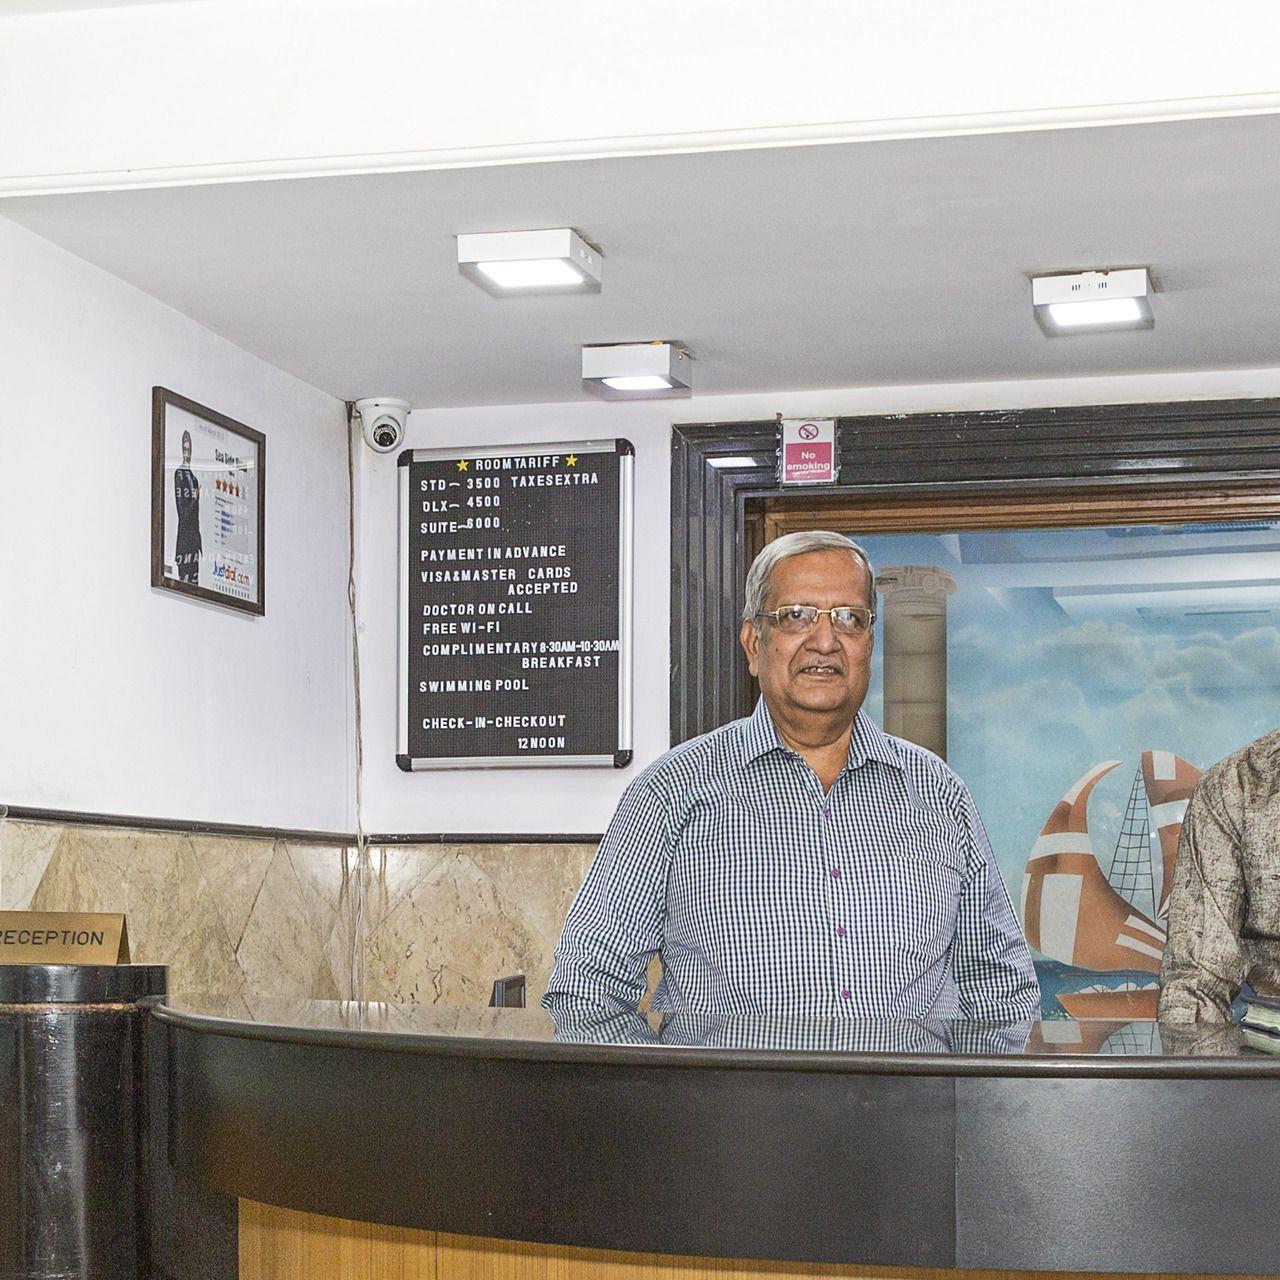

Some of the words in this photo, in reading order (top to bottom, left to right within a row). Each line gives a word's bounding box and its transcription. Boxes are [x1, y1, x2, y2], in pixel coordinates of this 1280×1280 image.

[801, 451, 816, 459] No
[786, 462, 831, 471] smoking
[466, 477, 500, 489] 3500
[466, 496, 500, 508] 4500
[466, 516, 500, 529] 6000
[421, 548, 484, 562] PAYMENT
[487, 547, 502, 559] IN
[505, 545, 566, 559] ADVANCE
[528, 566, 572, 580] CARDS
[507, 581, 578, 596] ACCEPTED
[422, 603, 475, 616] DOCTOR
[478, 603, 495, 615] ON
[498, 601, 533, 614] CALL
[423, 623, 457, 635] FREE
[460, 621, 500, 634] WI-FI
[422, 641, 538, 656] COMPLIMENTARY
[521, 656, 601, 669] BREAKFAST
[420, 679, 492, 693] SWIMMING
[495, 679, 530, 691] POOL
[517, 737, 528, 749] 12
[530, 736, 565, 749] NOON
